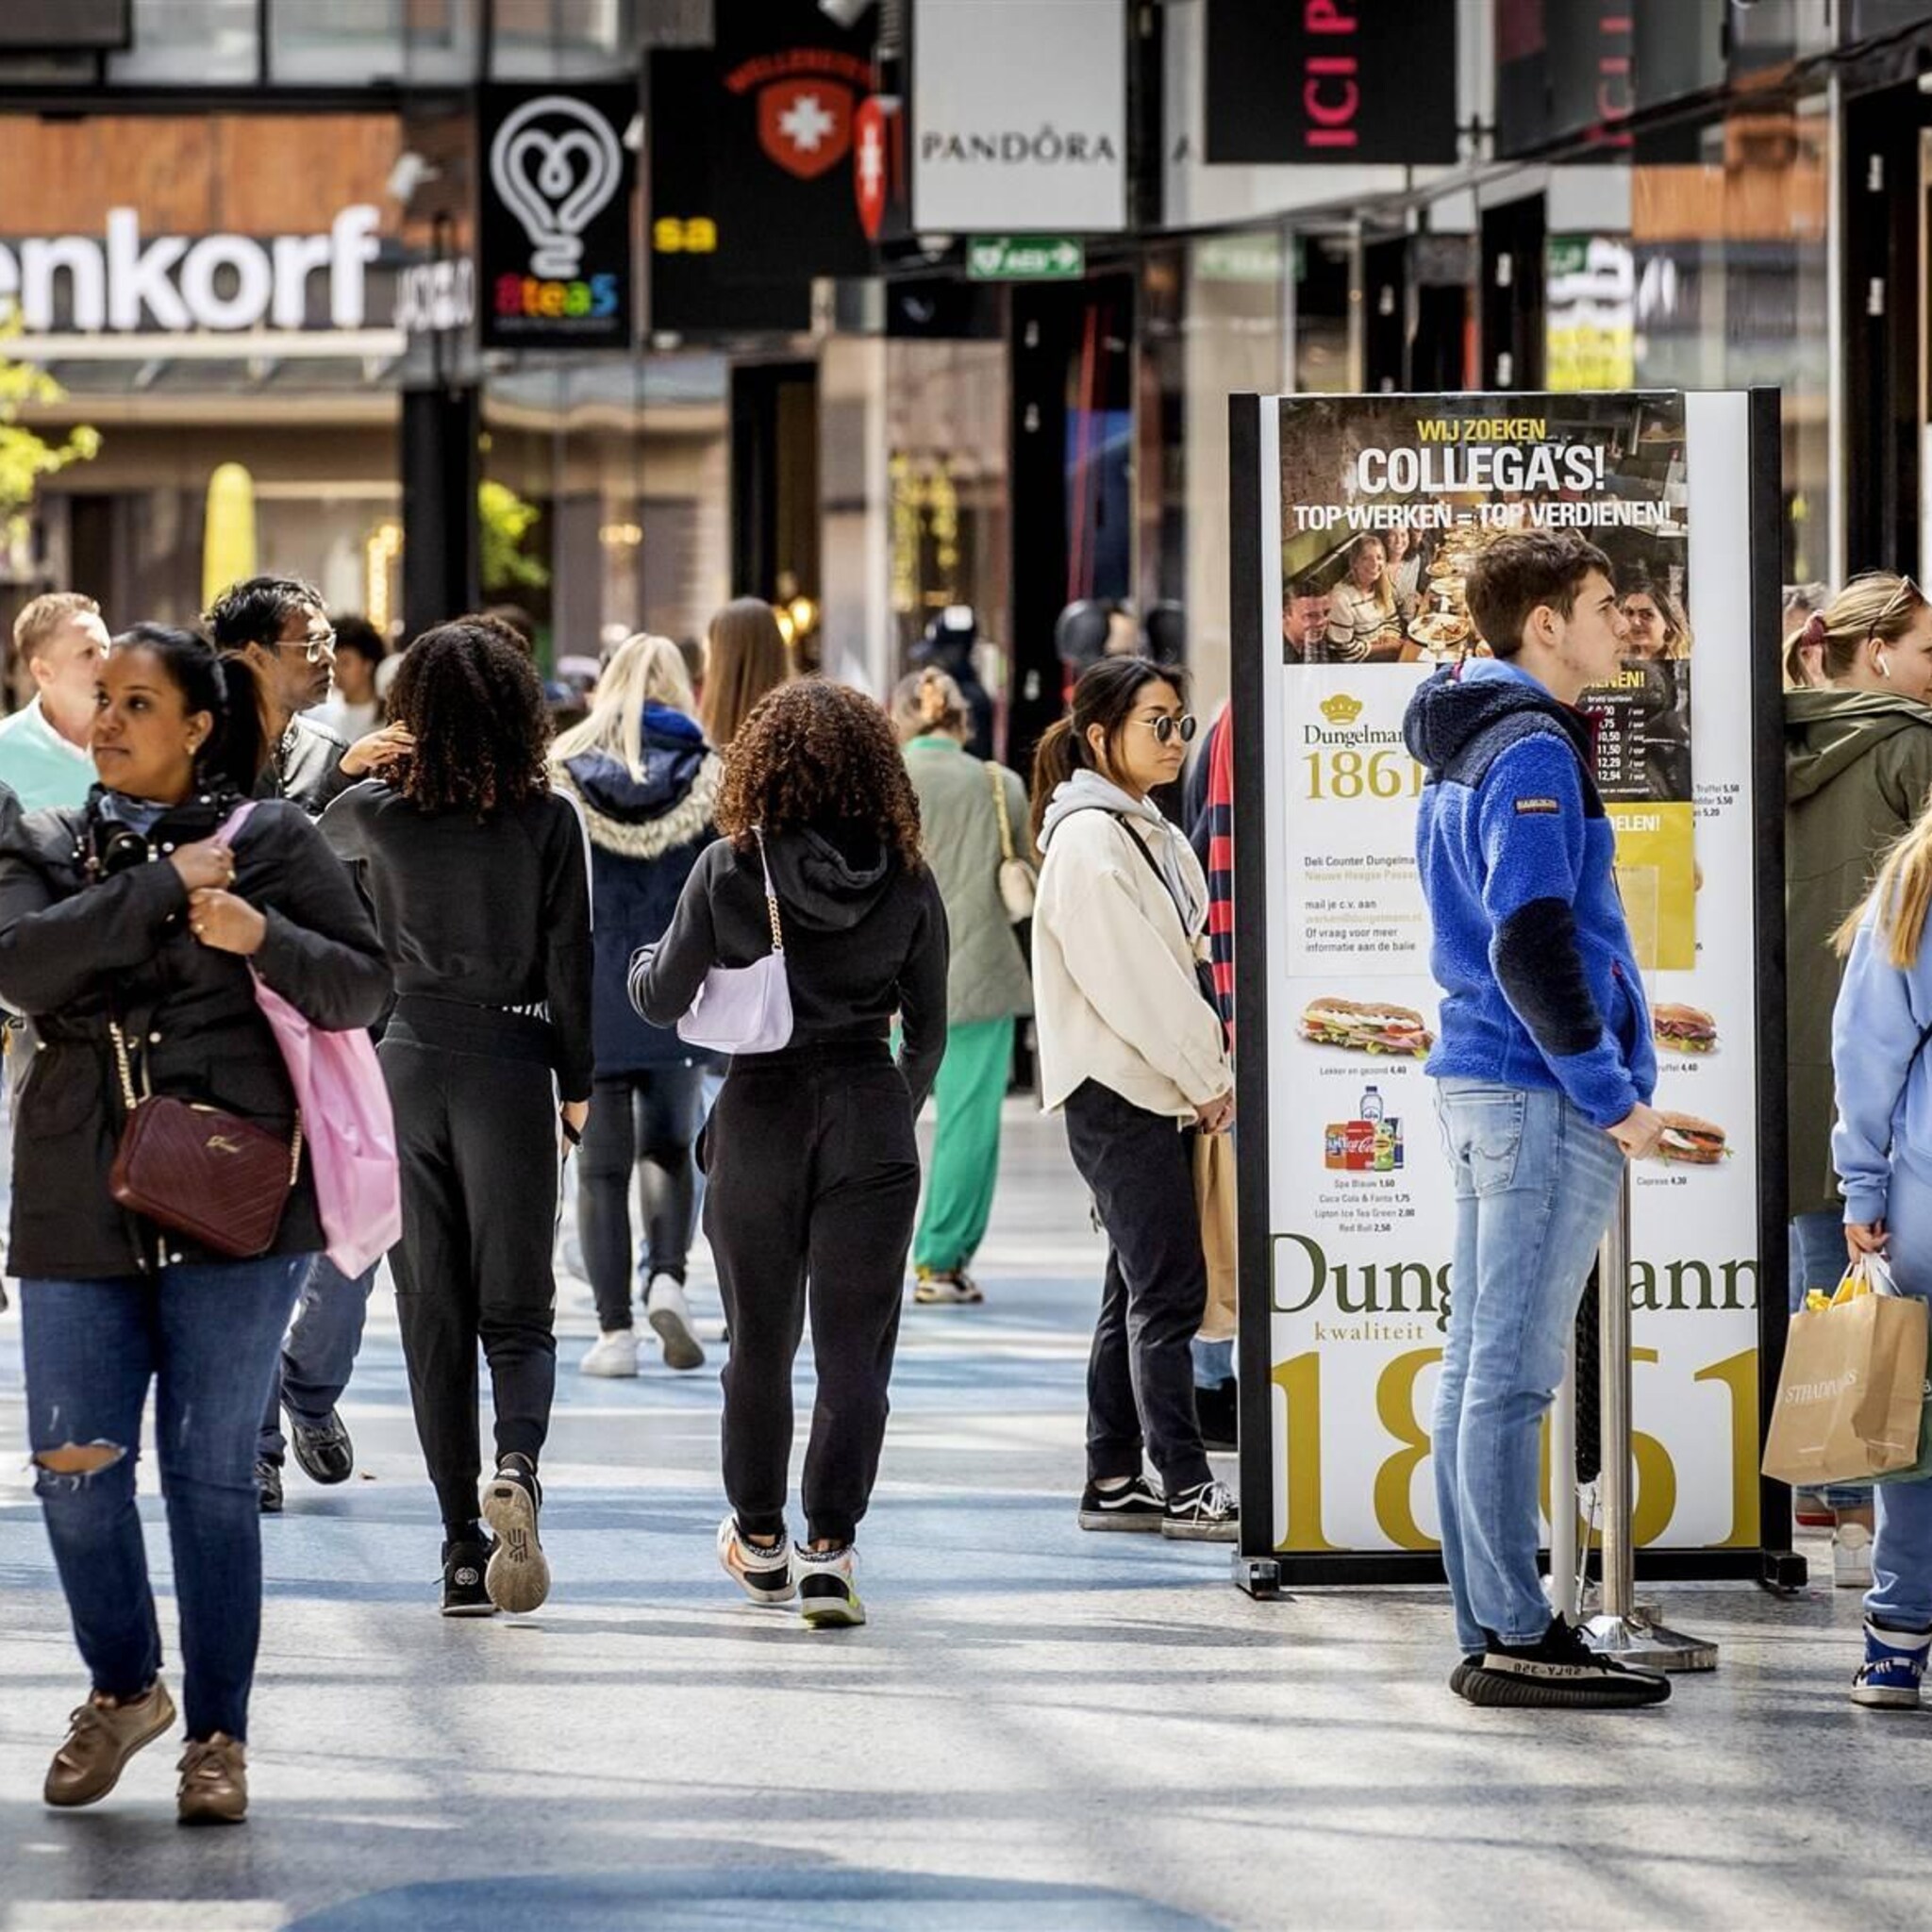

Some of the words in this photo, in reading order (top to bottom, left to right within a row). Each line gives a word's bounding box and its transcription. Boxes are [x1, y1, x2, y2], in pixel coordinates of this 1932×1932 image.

[0, 206, 381, 328] nkorf
[1418, 420, 1459, 441] WIJ
[1464, 419, 1546, 441] ZOEKEN
[1357, 445, 1605, 493] COLLEGA'S!
[1294, 505, 1341, 530] TOP
[1345, 504, 1452, 530] WERKEN
[1480, 504, 1524, 528] TOP
[1529, 501, 1671, 527] VERDIENEN!
[1305, 724, 1404, 748] Dungelma
[1302, 750, 1423, 799] 1861
[1616, 814, 1660, 832] ELEN!
[1305, 856, 1323, 867] Deli
[1325, 856, 1364, 867] Counter
[1366, 855, 1415, 867] Dungelma
[1306, 899, 1325, 909] mail
[1327, 899, 1337, 911] je
[1357, 900, 1377, 909] aan
[1306, 927, 1317, 938] Of
[1320, 928, 1347, 940] vraag
[1349, 928, 1371, 937] voor
[1373, 928, 1397, 937] meer
[1306, 942, 1355, 952] informatie
[1357, 943, 1375, 952] aan
[1378, 941, 1391, 951] de
[1392, 941, 1415, 951] balie
[1334, 1179, 1349, 1189] Spa
[1352, 1179, 1376, 1188] Blauw
[1319, 1194, 1340, 1203] Coca
[1341, 1194, 1359, 1203] Cola
[1357, 1208, 1370, 1217] Tea
[1340, 1224, 1355, 1232] Red
[1314, 1321, 1424, 1341] kwaliteit
